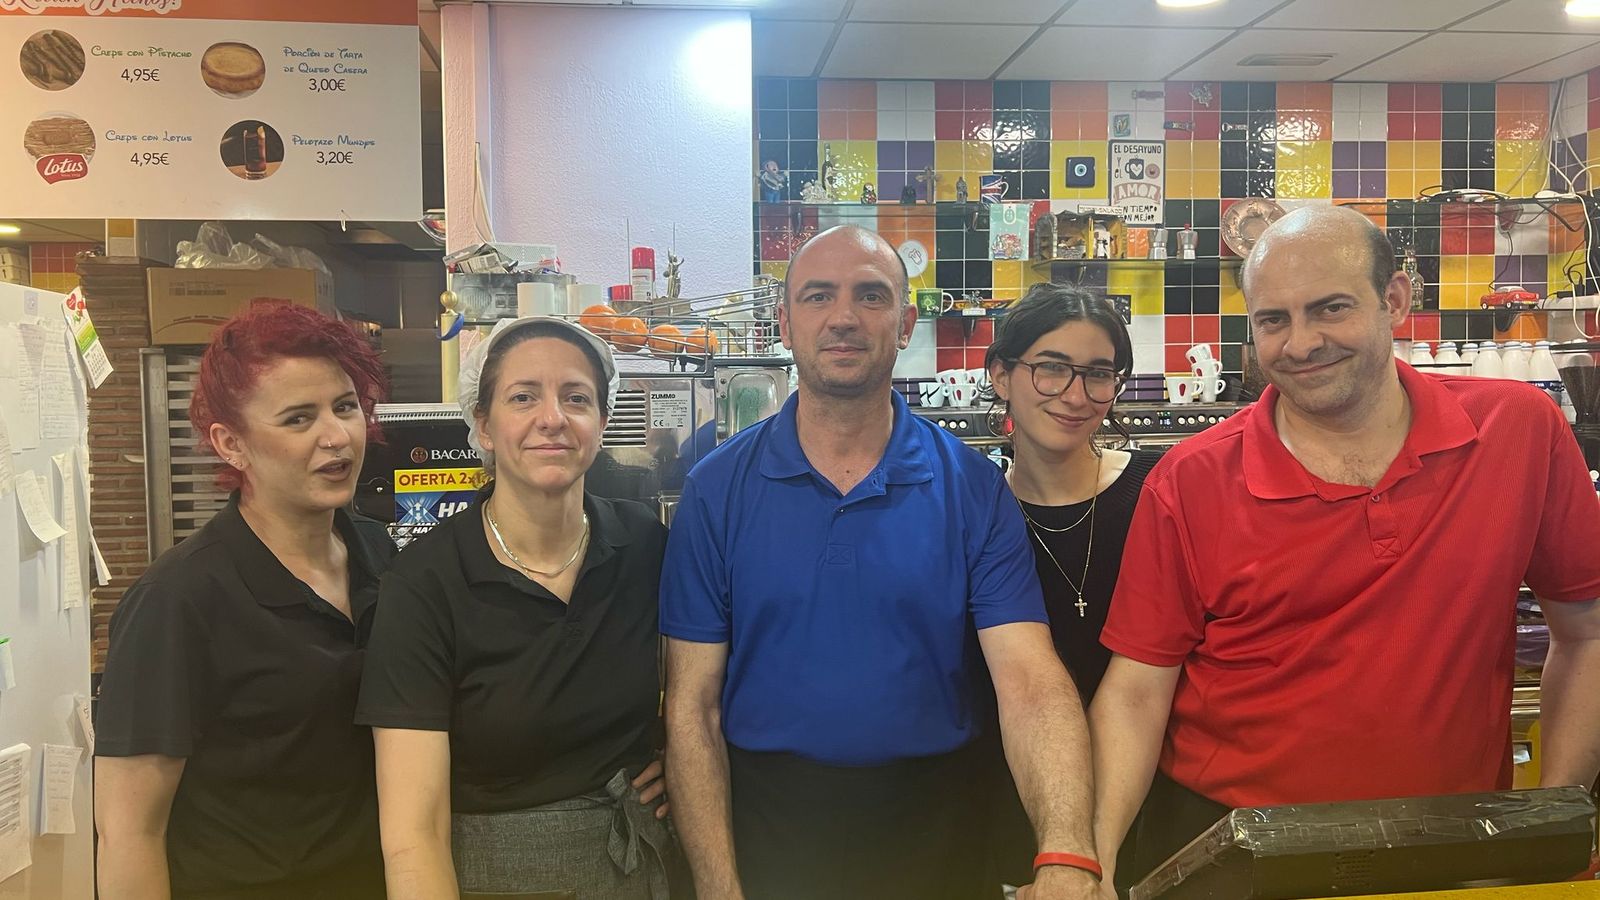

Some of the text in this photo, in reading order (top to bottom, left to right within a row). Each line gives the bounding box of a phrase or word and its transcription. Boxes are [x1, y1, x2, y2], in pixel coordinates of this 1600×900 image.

[121, 68, 160, 83] 4,95€
[308, 78, 346, 92] 3,00€
[1114, 144, 1162, 154] EL DESAYUNO
[130, 152, 170, 167] 4,95€
[316, 151, 354, 165] 3,20€
[44, 158, 84, 176] Lotus
[1118, 183, 1157, 198] AMOR
[431, 449, 480, 460] BACAR
[399, 473, 456, 486] OFERTA
